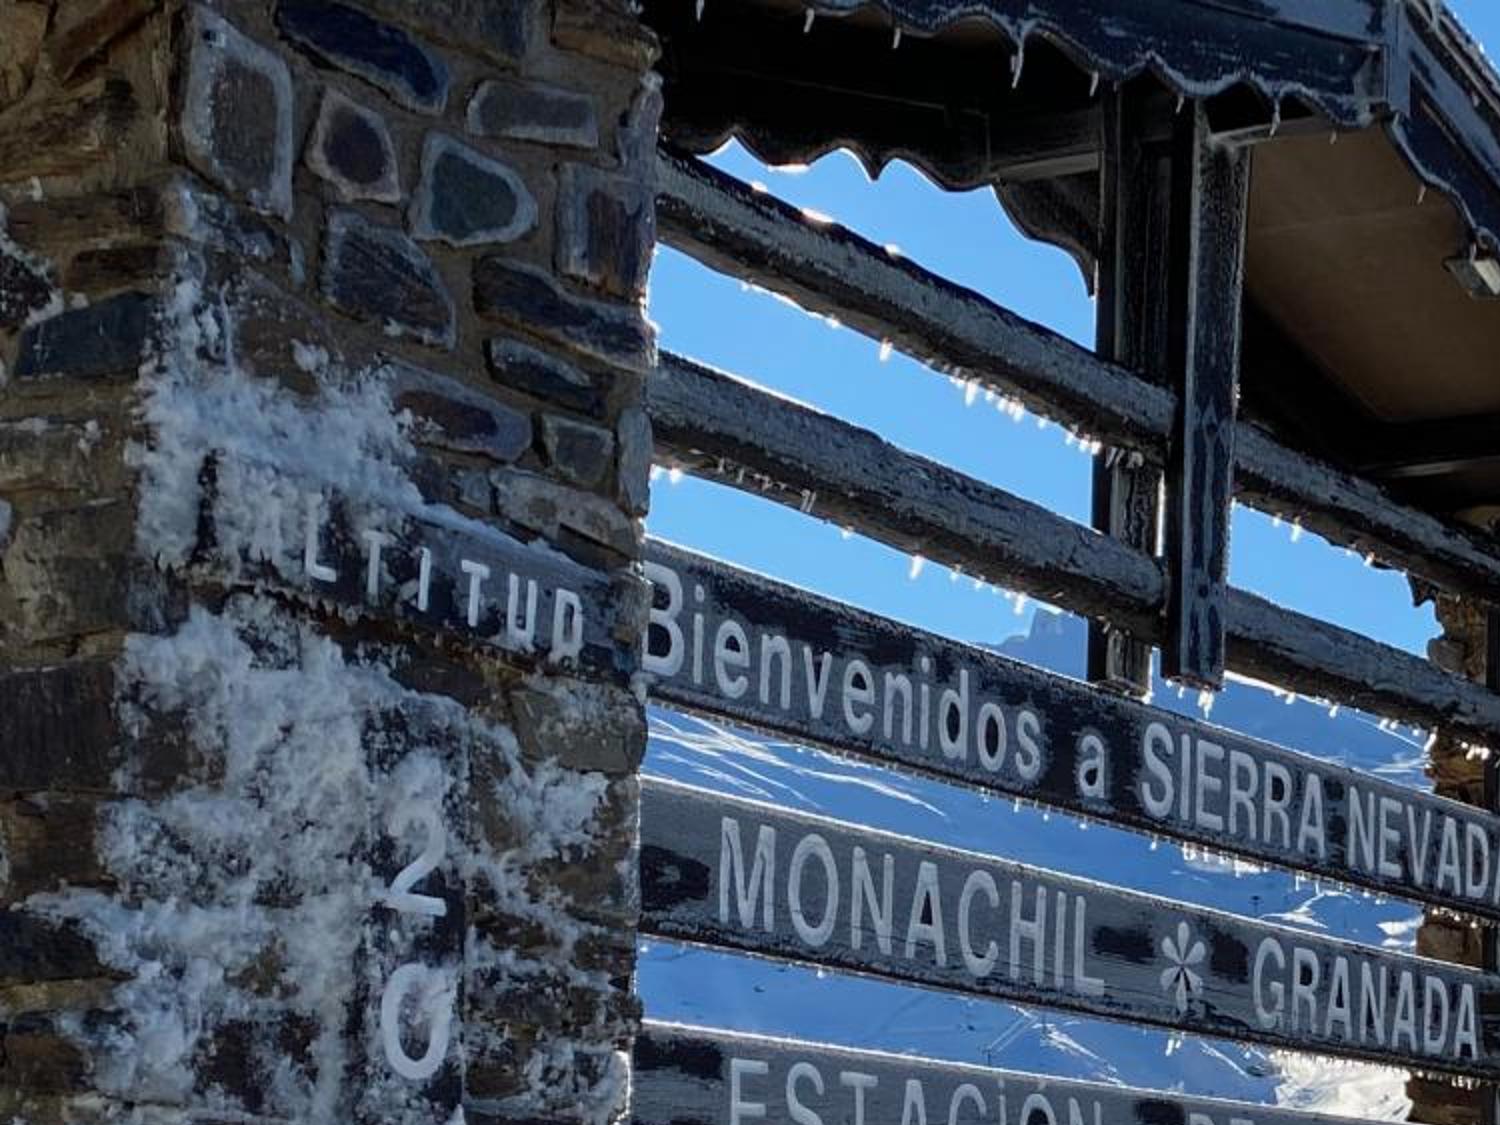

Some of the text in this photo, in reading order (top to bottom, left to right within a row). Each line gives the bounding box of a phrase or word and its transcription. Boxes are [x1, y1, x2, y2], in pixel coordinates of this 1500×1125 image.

[641, 560, 1043, 781] Bienvenidos
[1077, 734, 1106, 799] a
[1141, 722, 1326, 861] SIERRA
[719, 816, 1479, 1062] MONACHIL GRANADA
